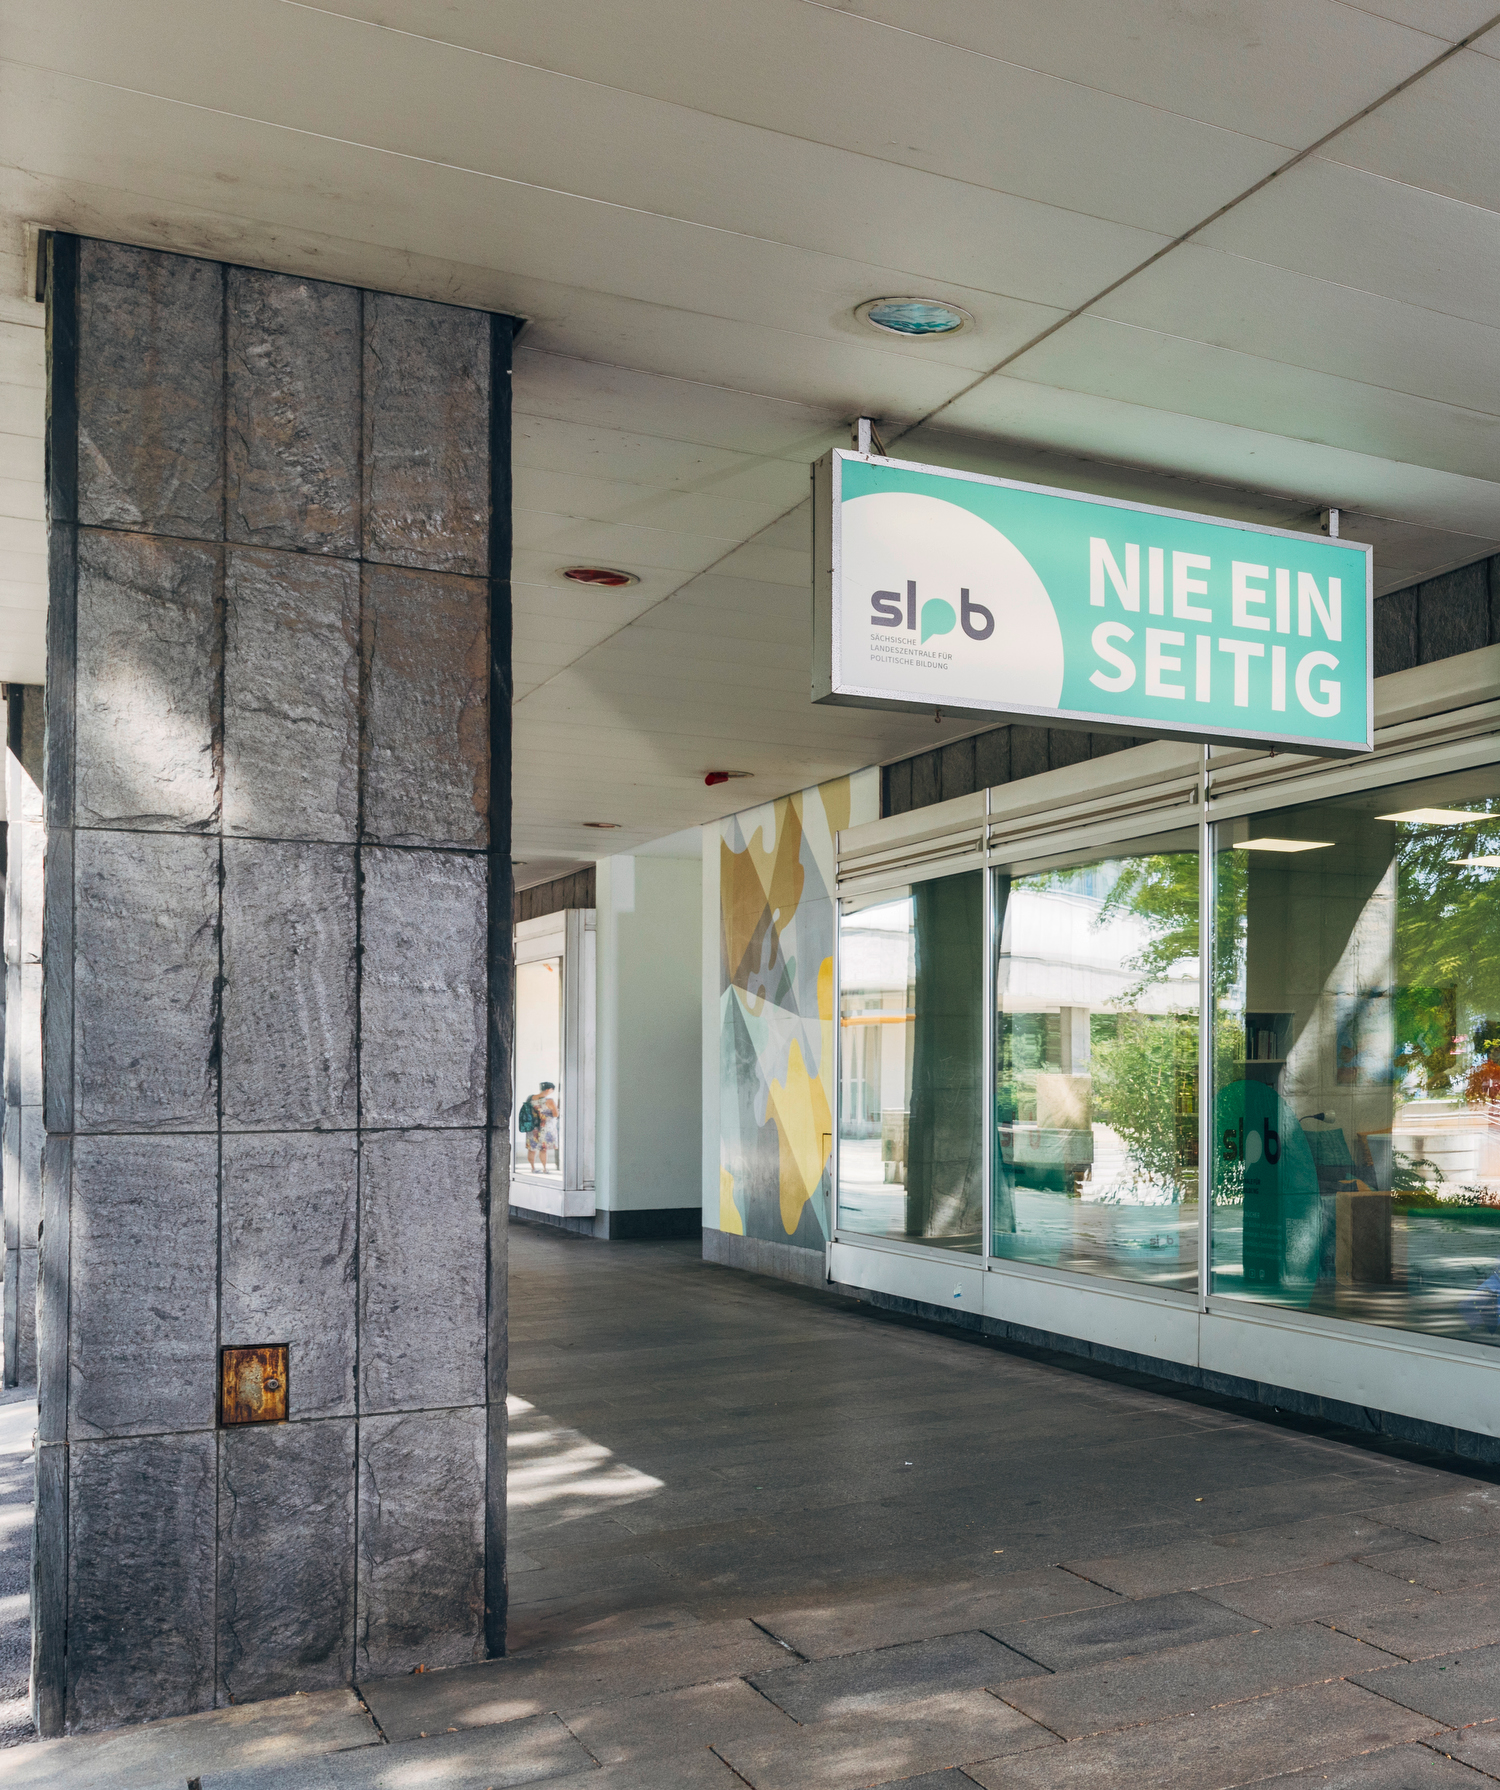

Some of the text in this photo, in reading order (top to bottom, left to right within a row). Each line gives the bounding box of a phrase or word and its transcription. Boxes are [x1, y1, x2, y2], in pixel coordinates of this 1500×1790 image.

[1089, 536, 1342, 642] NIE EIN
[870, 633, 917, 646] SÄCHSISCHE
[870, 644, 953, 660] LANDESZENTRALE FÜR
[870, 654, 948, 670] POLITISCHE BILDUNG
[1088, 621, 1341, 718] SEITIG
